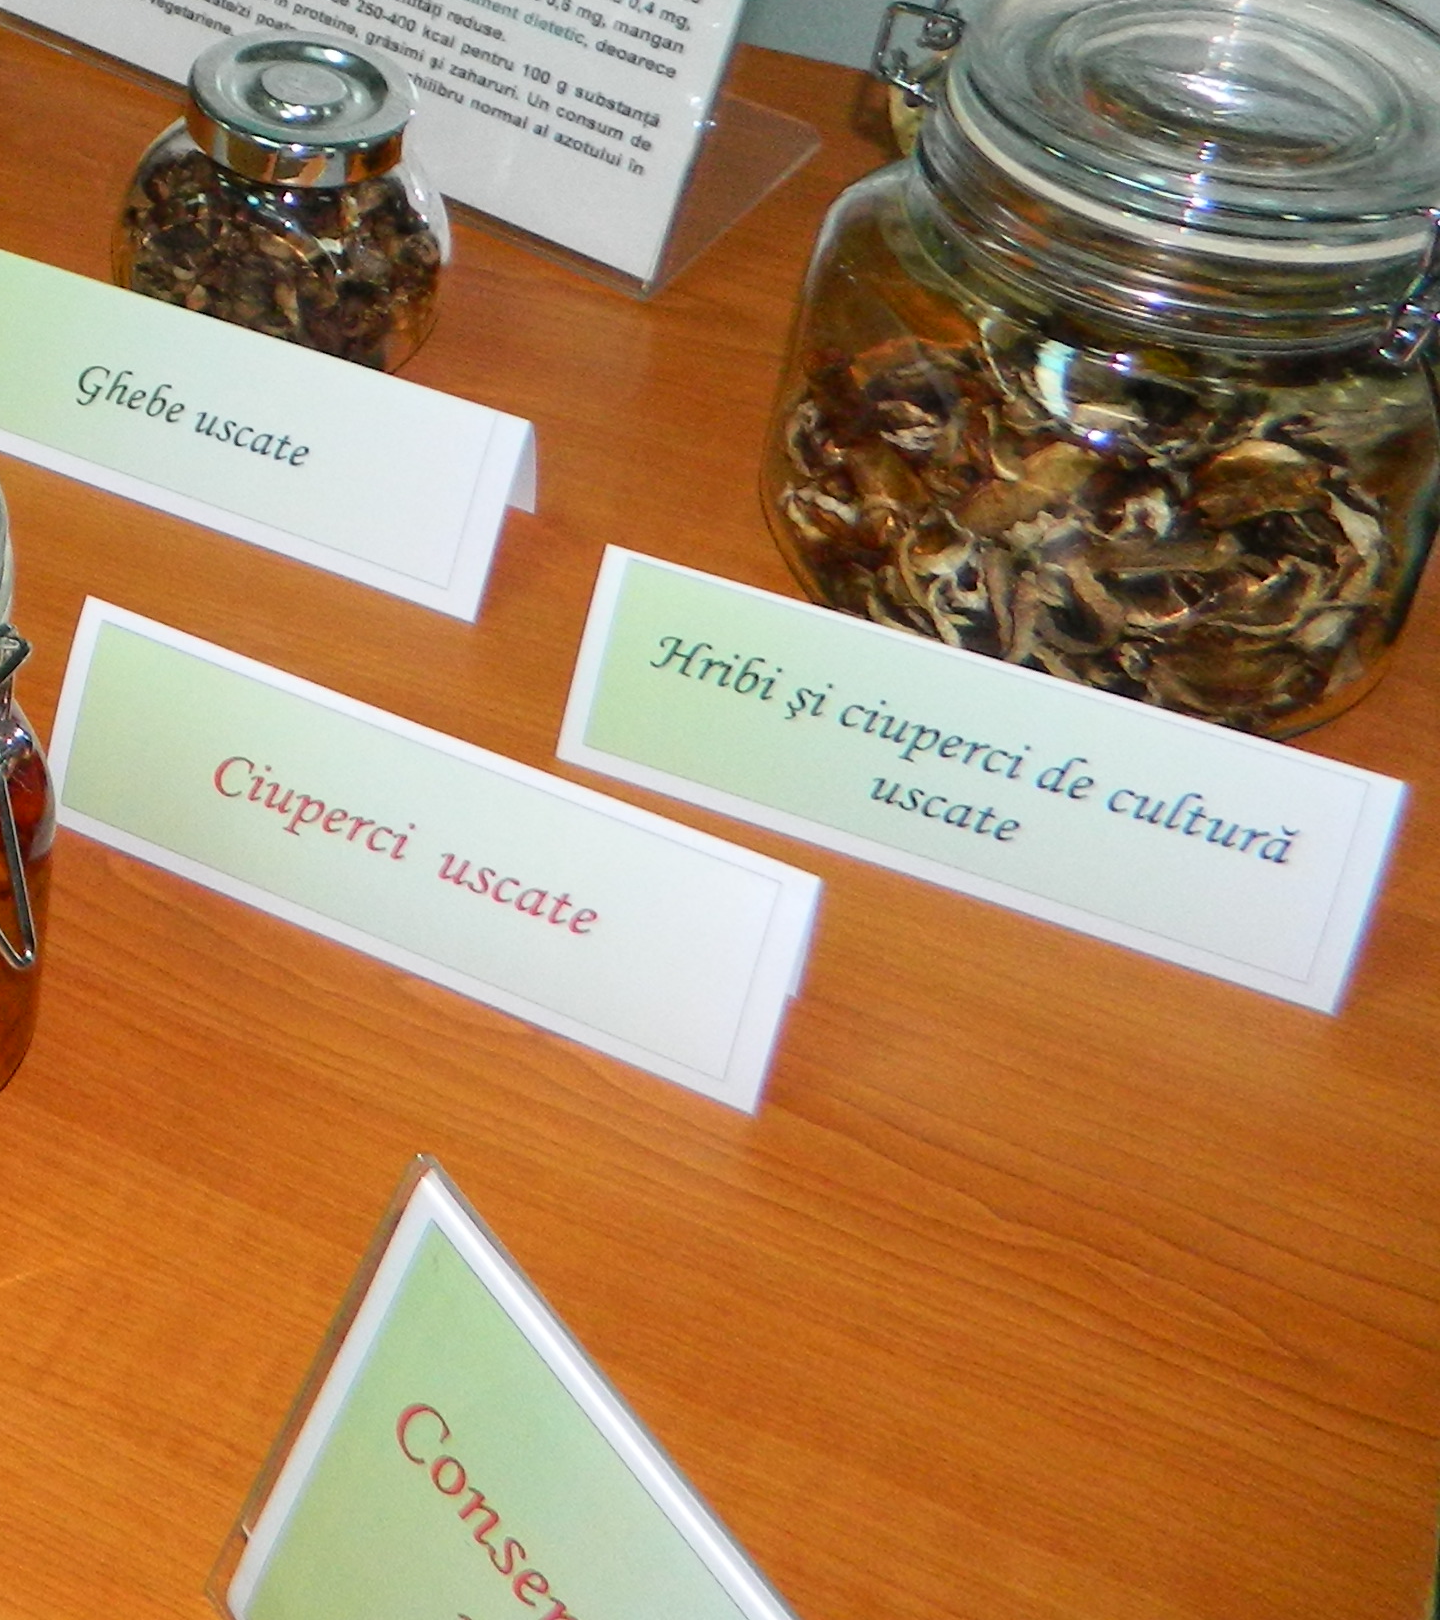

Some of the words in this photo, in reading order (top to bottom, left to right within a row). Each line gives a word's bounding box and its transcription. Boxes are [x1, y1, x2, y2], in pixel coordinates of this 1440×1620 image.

[76, 364, 187, 425] Ghebe
[193, 410, 311, 469] uscate
[649, 635, 780, 703] Hribi
[838, 698, 1033, 783] ciuperci
[1036, 756, 1097, 802] de
[1106, 788, 1301, 867] cultură
[870, 776, 1023, 844] uscate
[212, 755, 417, 862] Ciuperci
[437, 852, 600, 937] uscate
